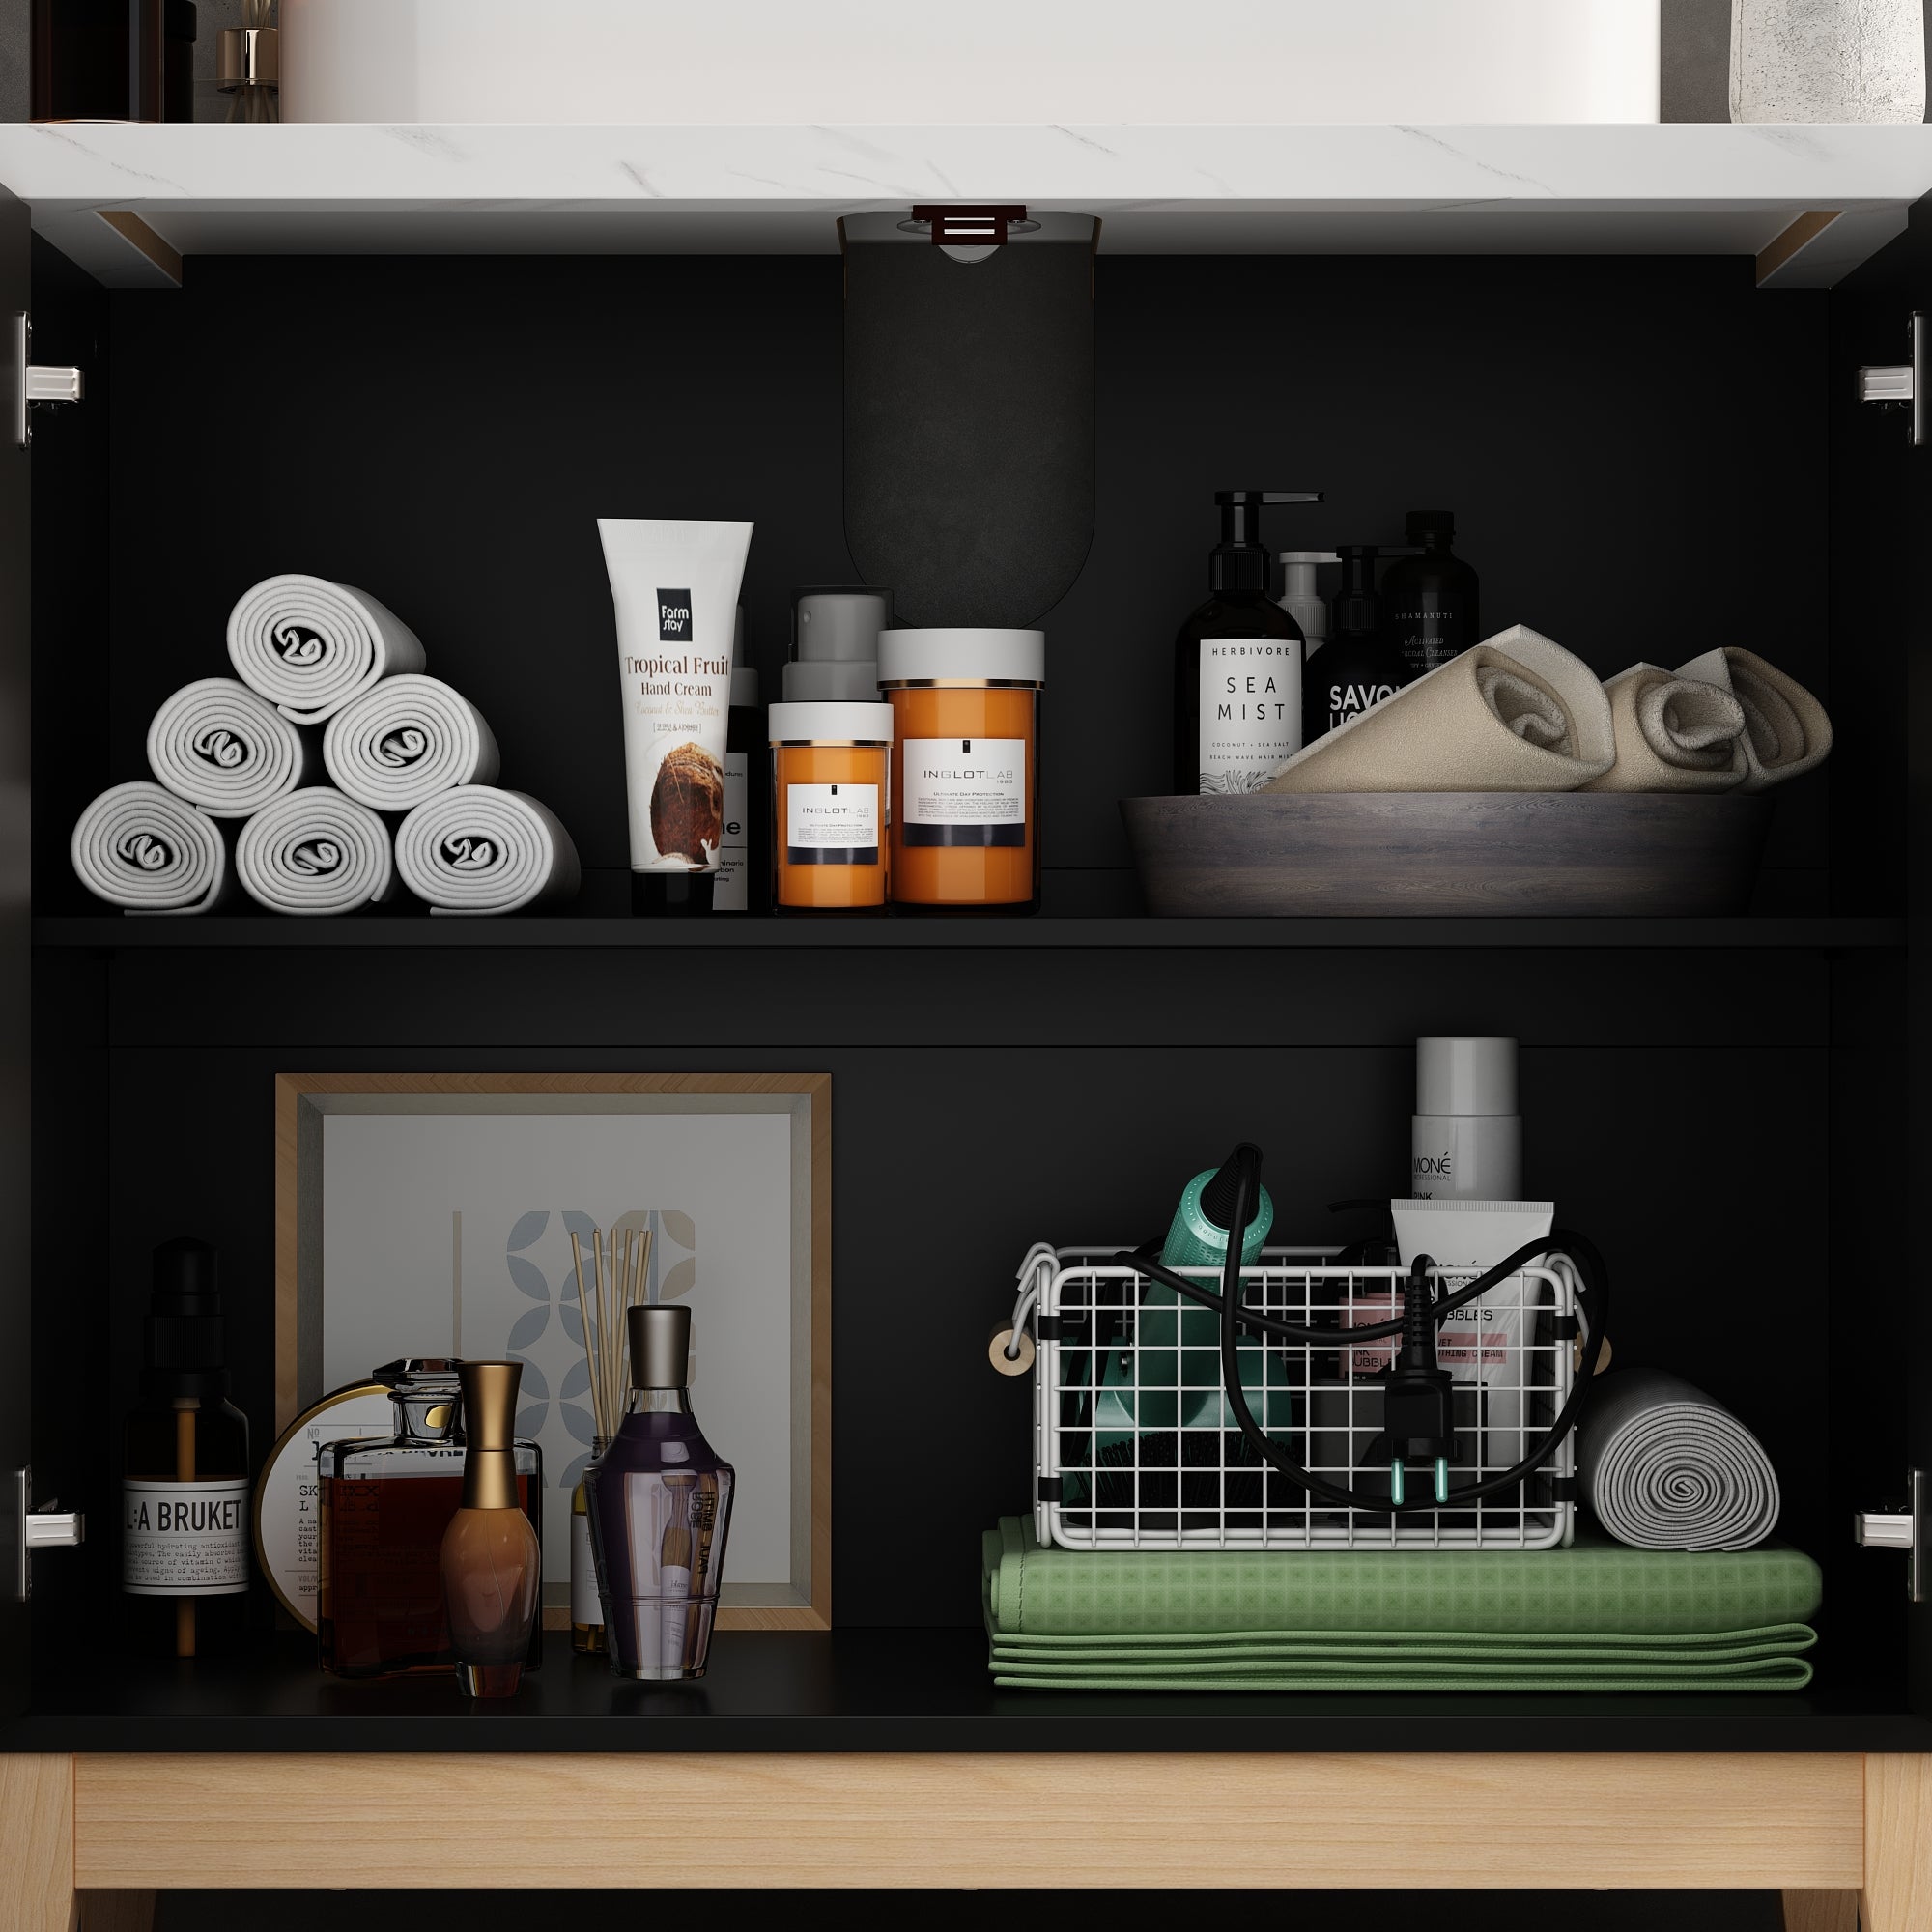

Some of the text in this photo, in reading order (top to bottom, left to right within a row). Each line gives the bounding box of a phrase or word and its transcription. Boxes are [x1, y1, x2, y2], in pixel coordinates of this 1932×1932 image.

[661, 604, 689, 619] Farm
[663, 618, 683, 633] stay
[1212, 647, 1290, 656] HERBIVORE
[625, 654, 688, 678] Tropical
[641, 681, 712, 696] Hand Cream
[1227, 676, 1276, 694] SEA
[1217, 703, 1285, 721] MIST
[923, 770, 1013, 779] INGLOTLAB
[158, 1500, 242, 1532] BRUKET
[157, 1542, 197, 1550] hydrating
